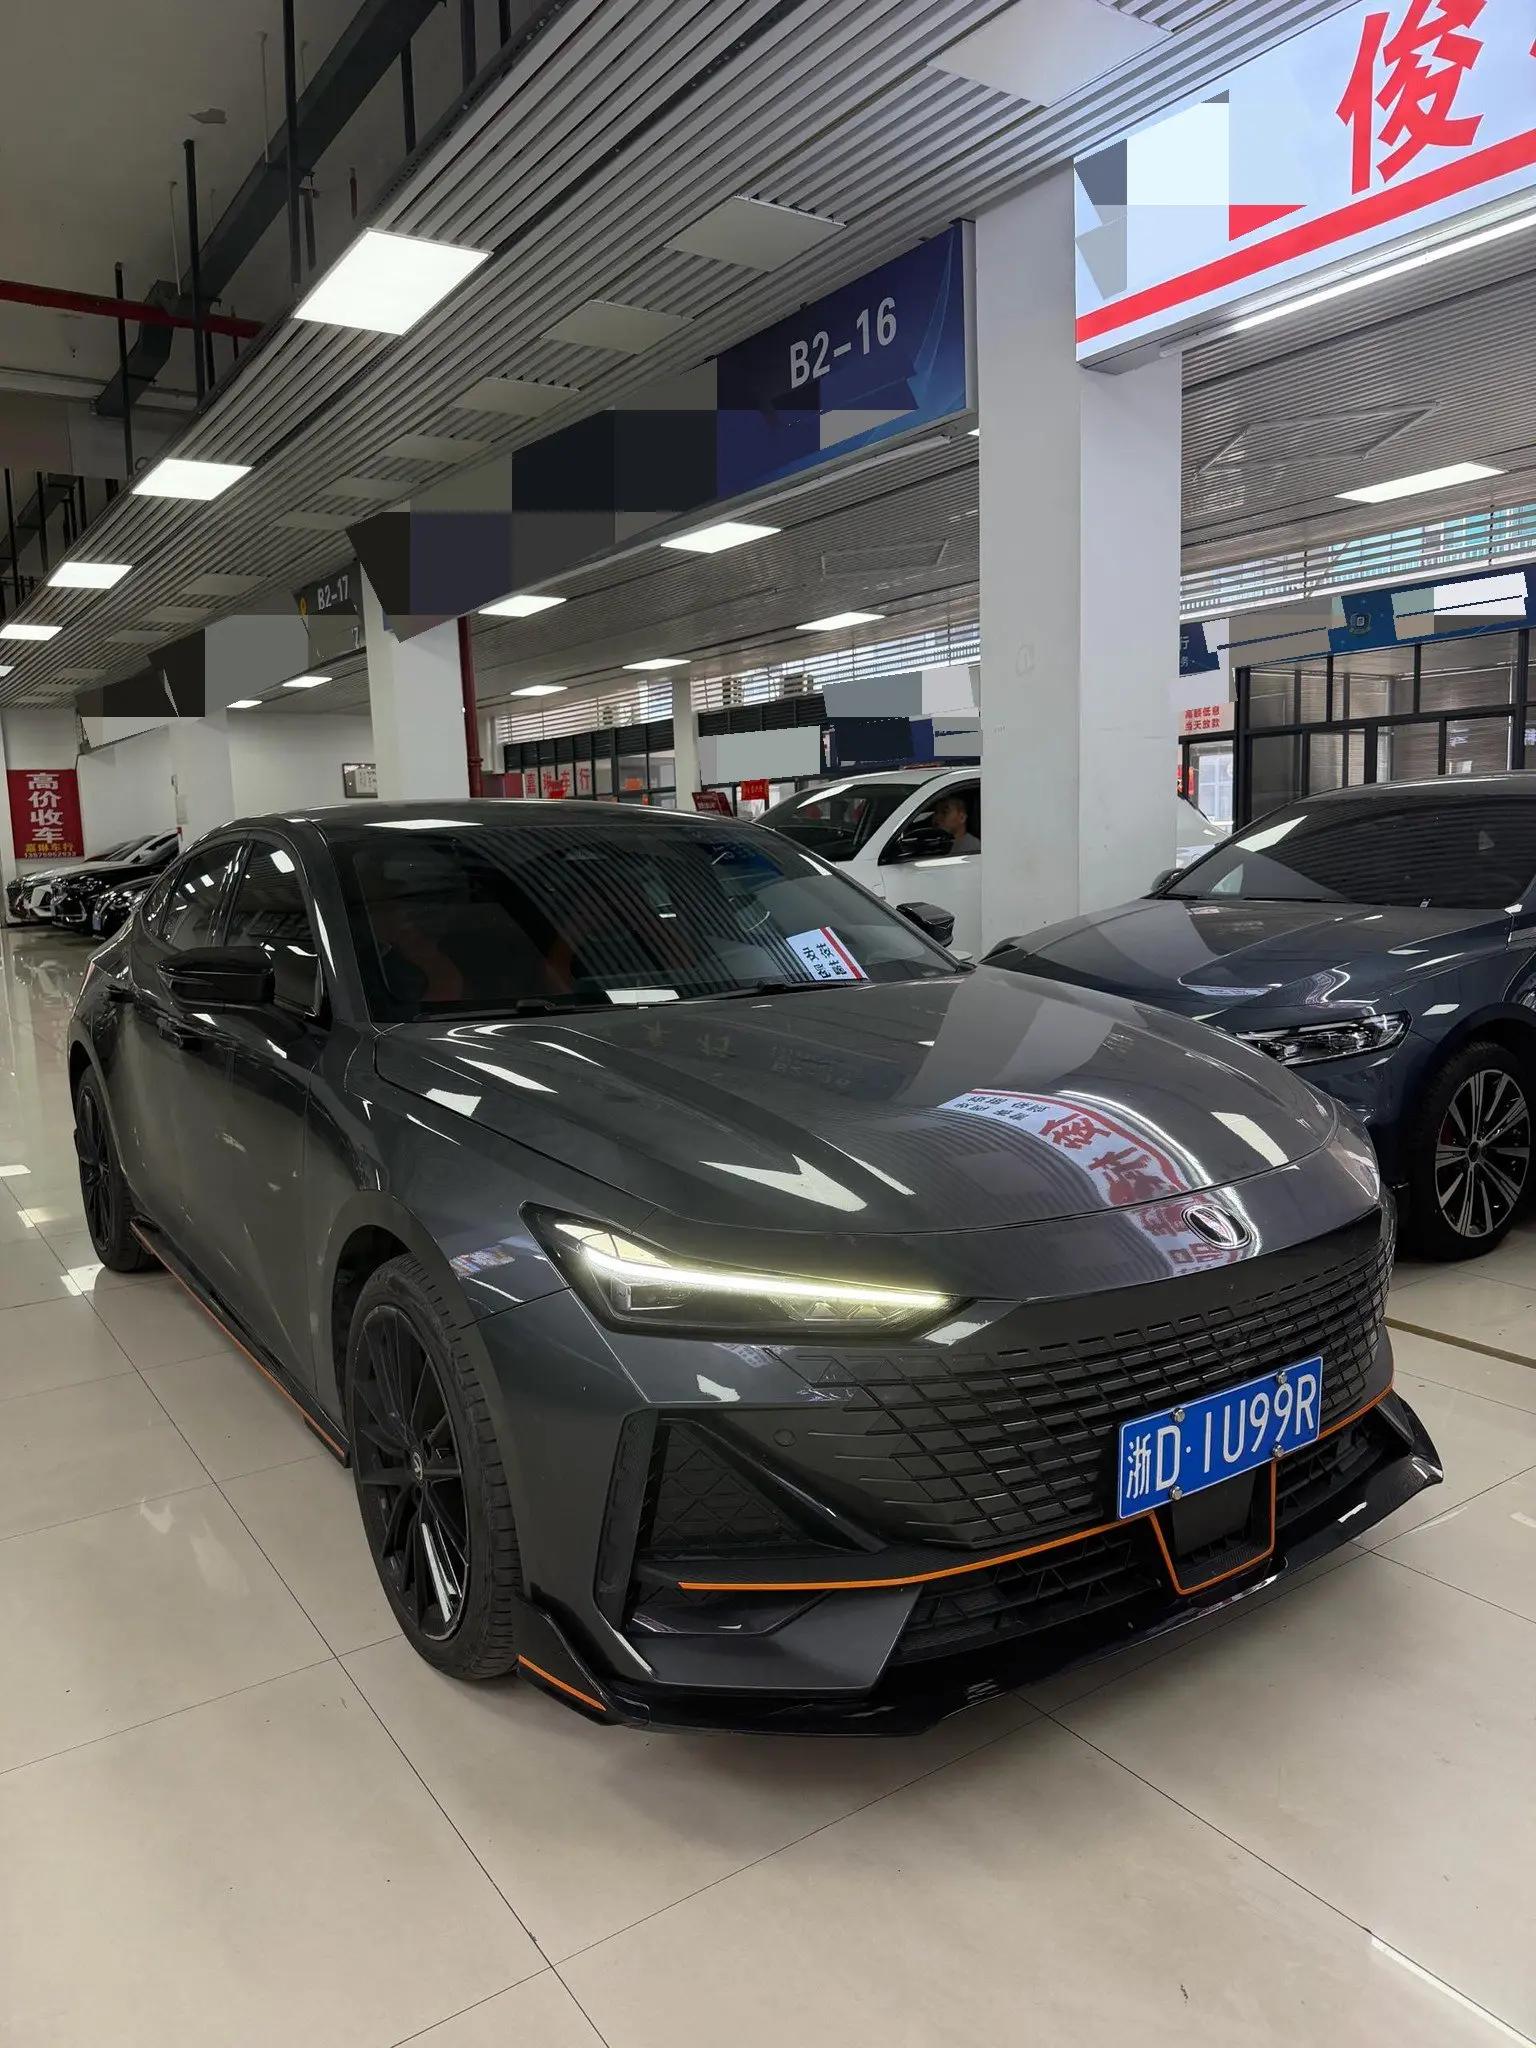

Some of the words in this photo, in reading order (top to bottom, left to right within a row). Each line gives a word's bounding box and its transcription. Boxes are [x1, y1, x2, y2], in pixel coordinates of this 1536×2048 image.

[1335, 0, 1536, 196] 俊
[789, 296, 897, 389] B2-16
[317, 574, 349, 611] B2-17
[1185, 719, 1220, 731] 当天放款
[25, 772, 65, 844] 高价收车
[1126, 1373, 1317, 1500] 浙D·1U99R
